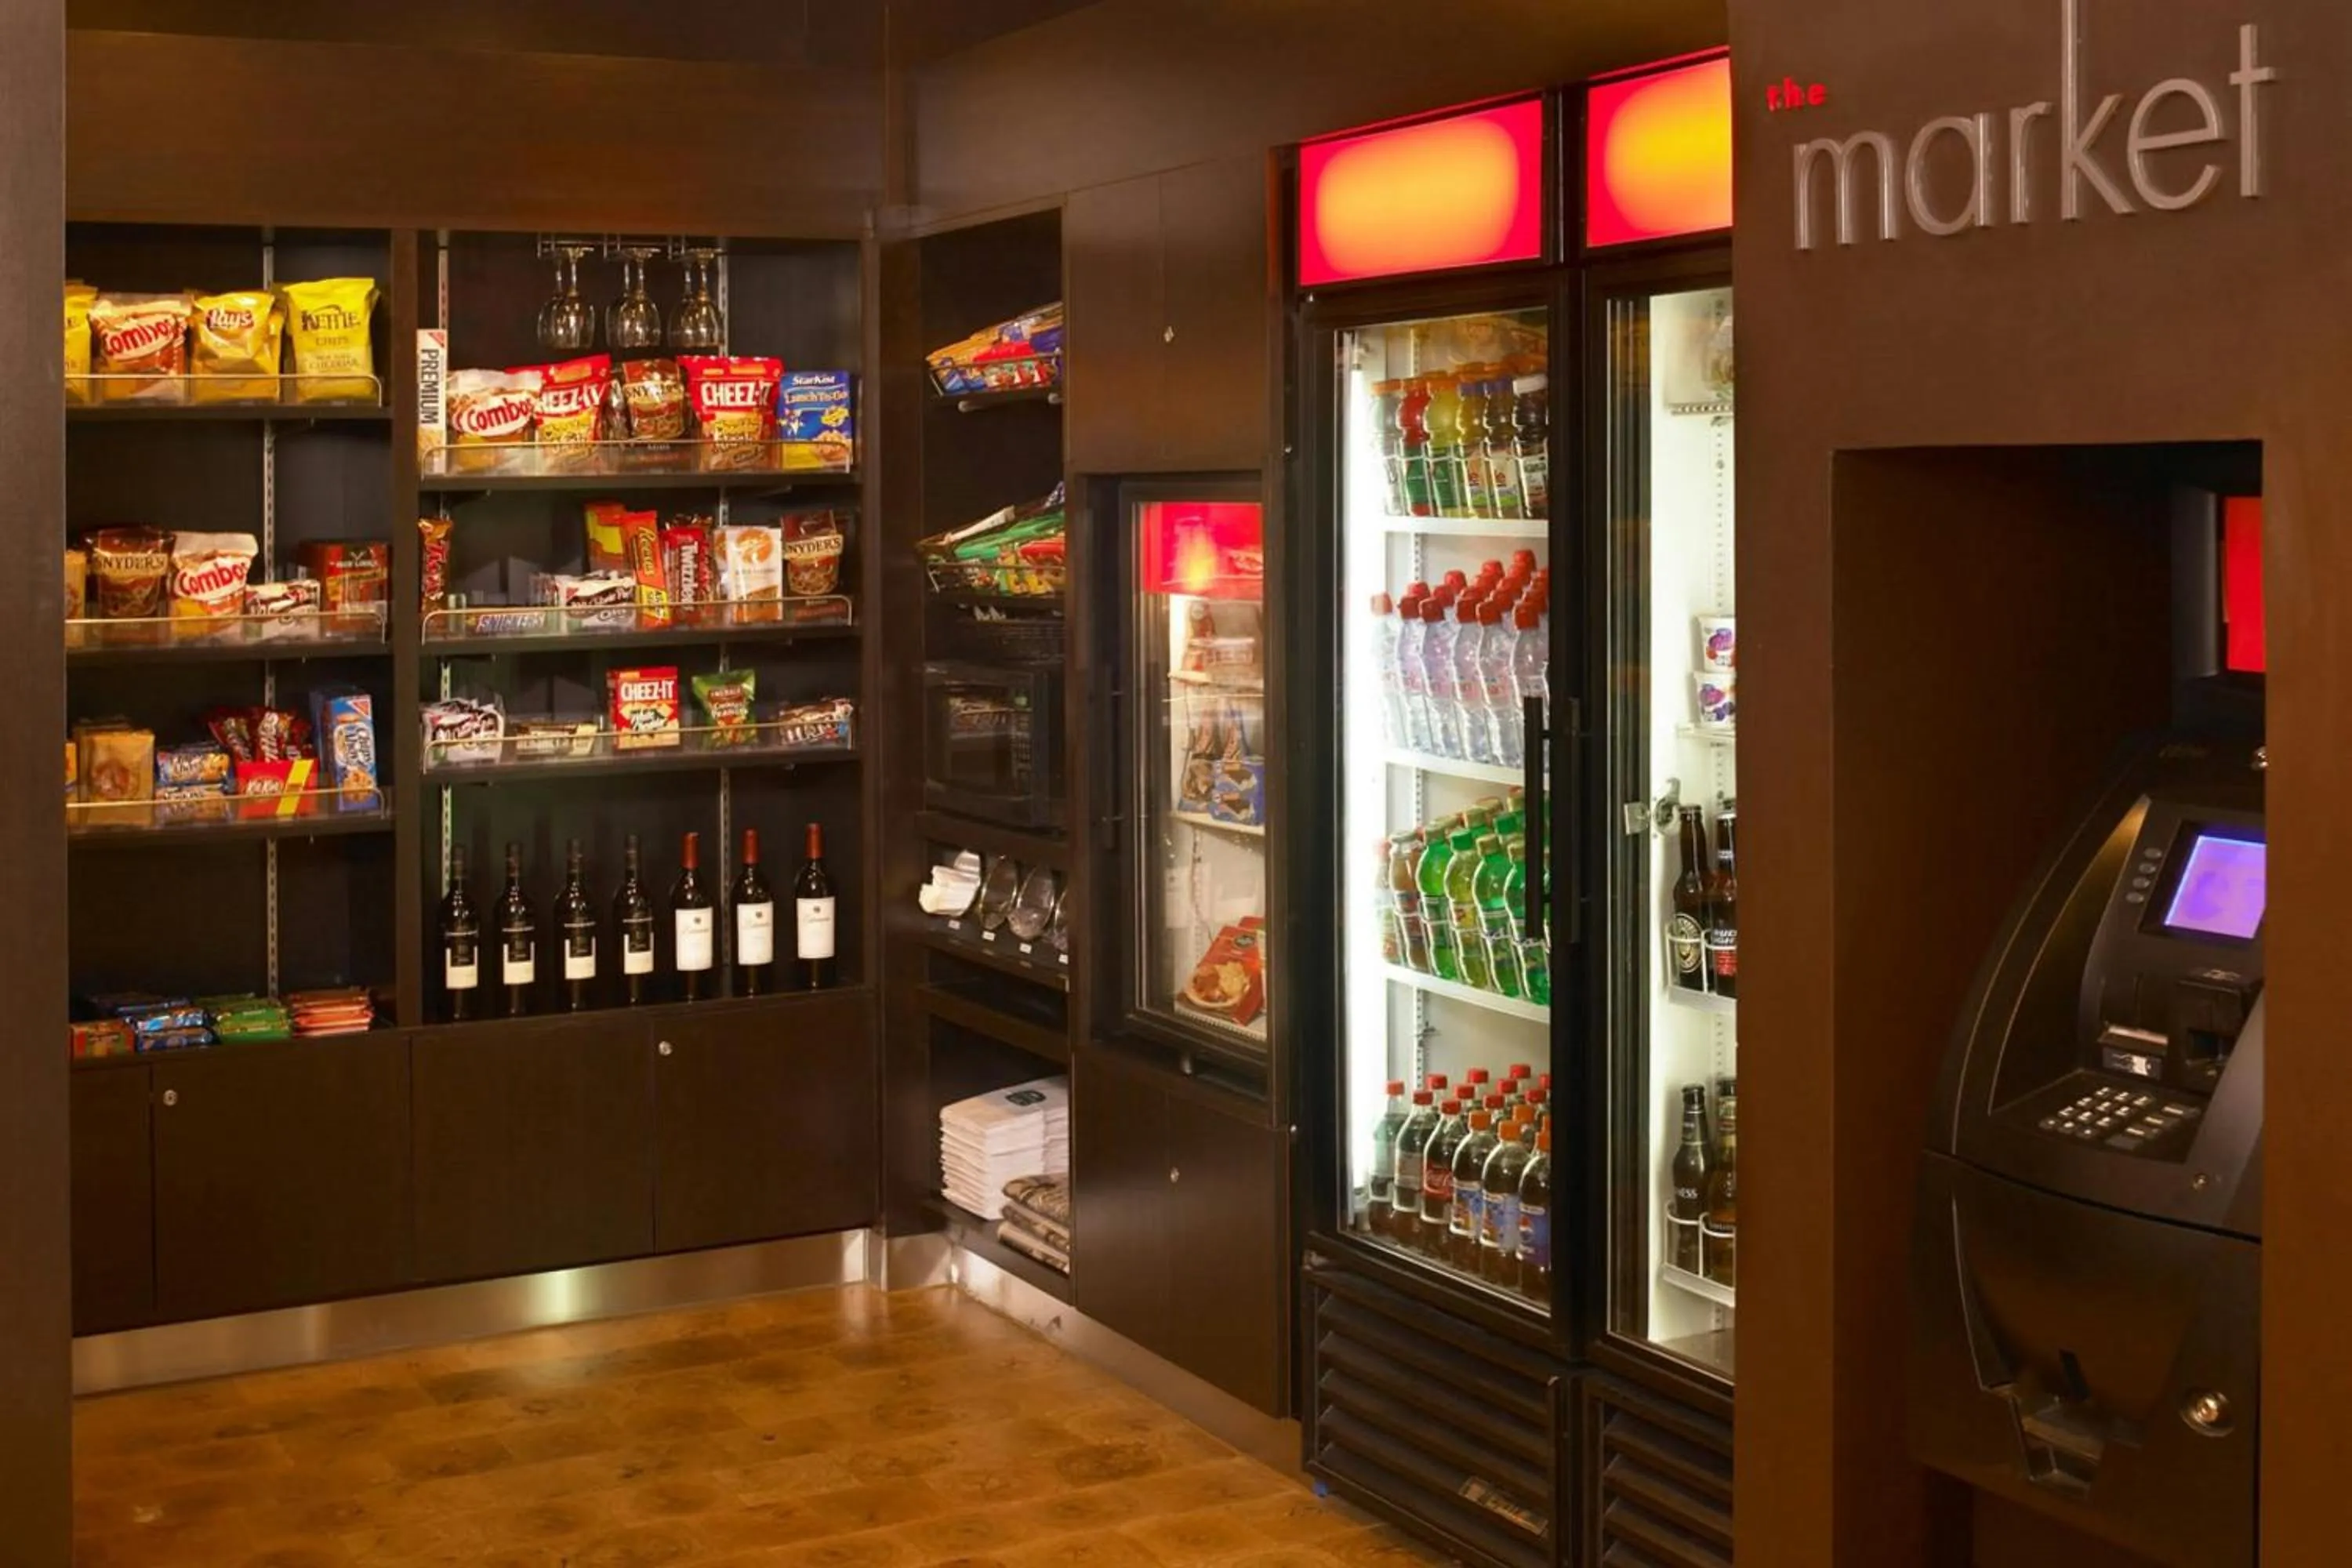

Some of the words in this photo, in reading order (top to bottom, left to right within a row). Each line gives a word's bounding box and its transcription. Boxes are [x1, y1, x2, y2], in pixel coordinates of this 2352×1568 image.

[1766, 77, 1826, 112] the
[1793, 0, 2276, 250] market
[301, 309, 361, 332] KETTLE
[420, 348, 440, 424] PREMIUM
[542, 384, 606, 413] HEEZ-IT
[700, 381, 773, 408] CHEEZ-IT
[466, 397, 534, 432] Combos
[179, 561, 247, 596] Combos
[475, 614, 546, 633] SNICKERS
[620, 681, 675, 702] CHEEZ-IT
